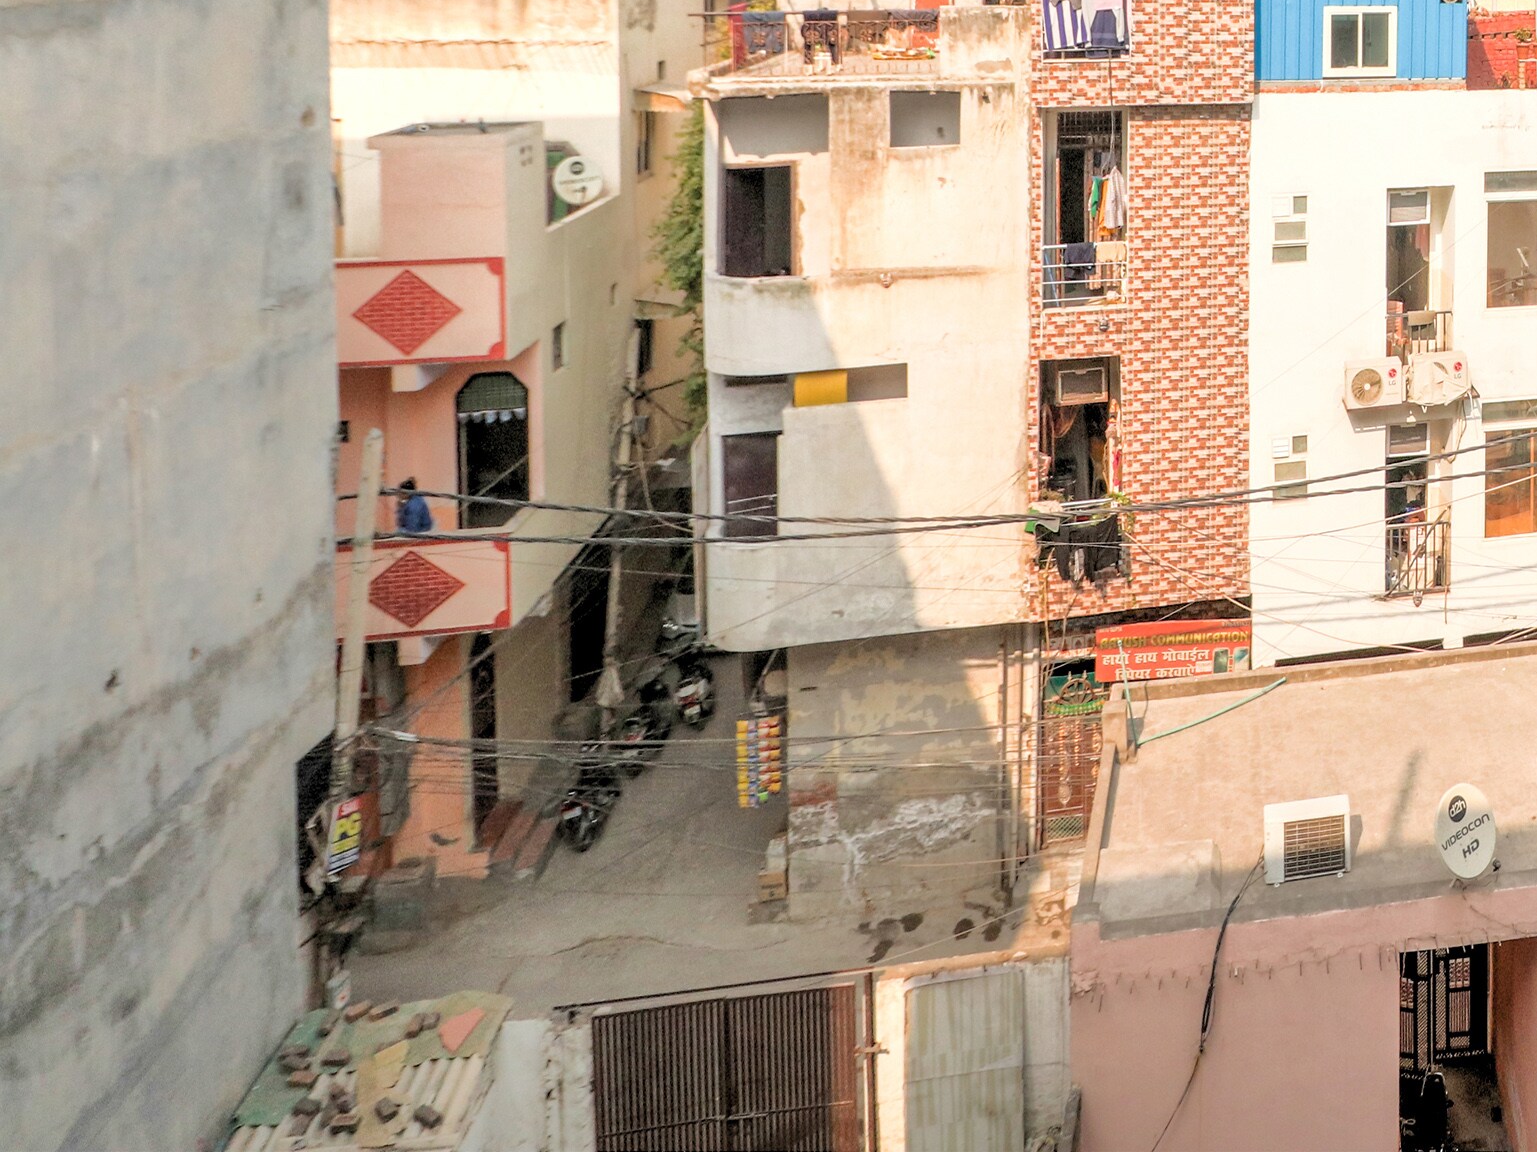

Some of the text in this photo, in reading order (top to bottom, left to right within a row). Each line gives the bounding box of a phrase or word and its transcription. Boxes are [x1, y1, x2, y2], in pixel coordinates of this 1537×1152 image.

[1151, 631, 1248, 645] COMMUNICATION
[1449, 800, 1466, 817] d2h
[1442, 814, 1490, 850] VIDEOCON
[1462, 839, 1480, 858] HD
